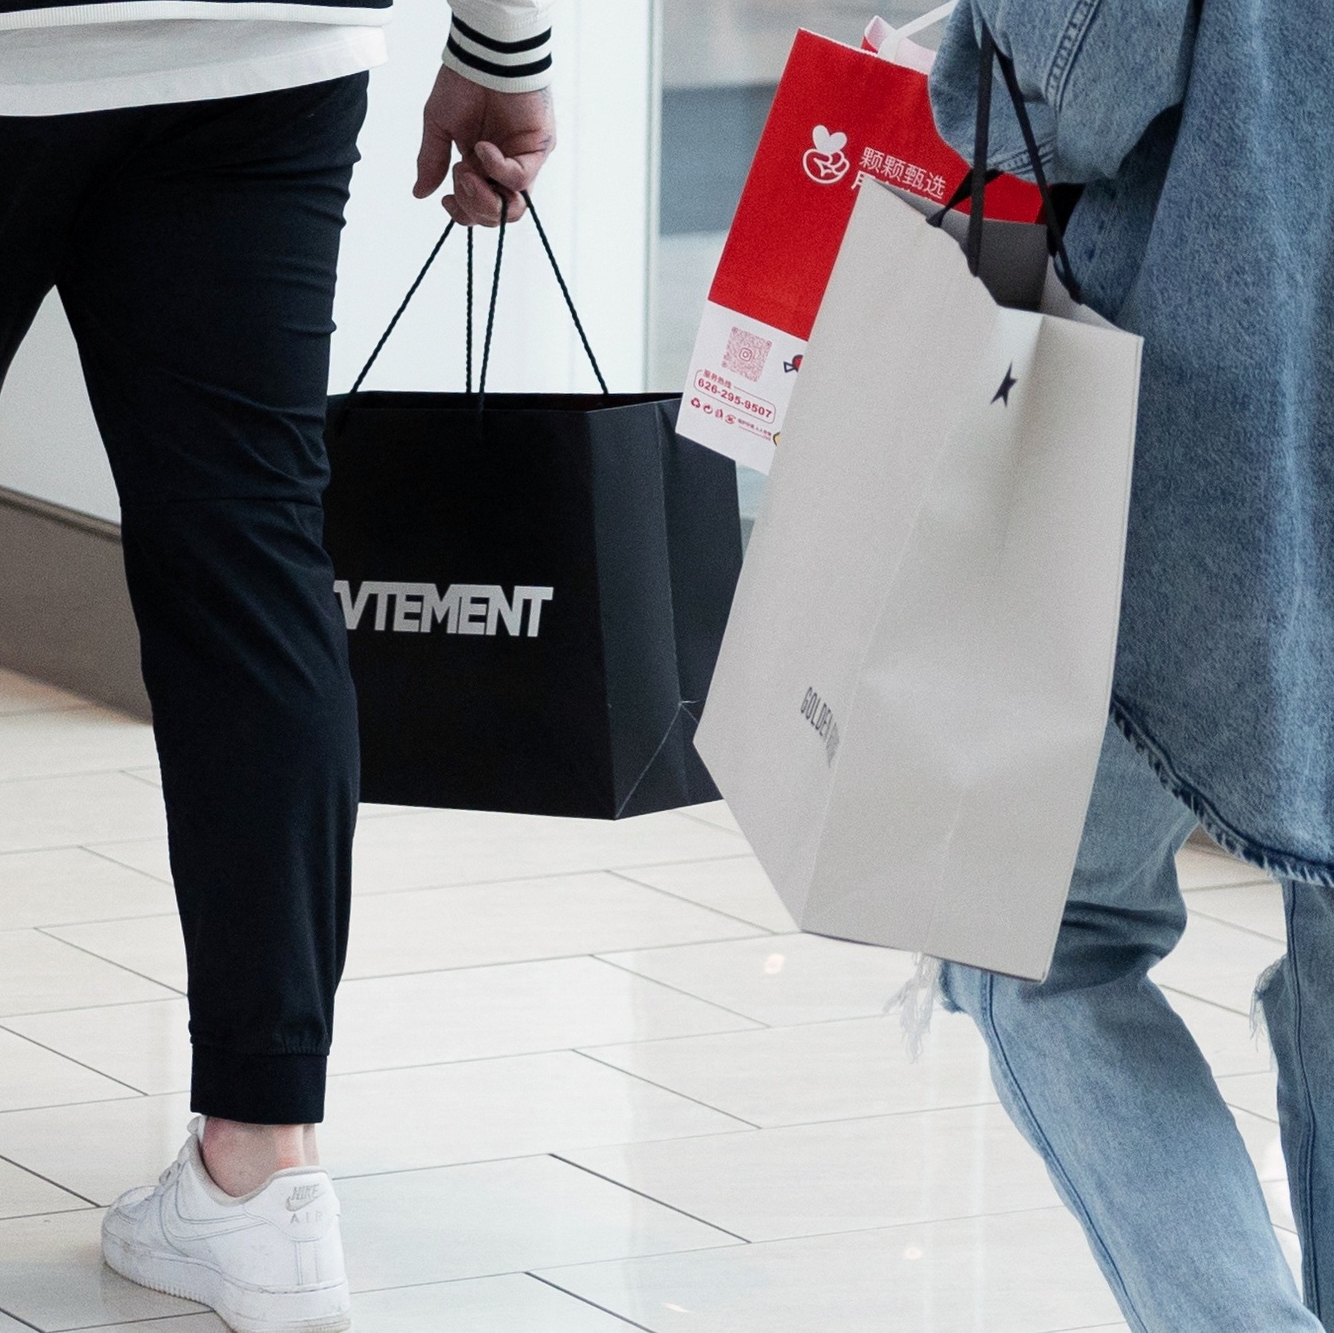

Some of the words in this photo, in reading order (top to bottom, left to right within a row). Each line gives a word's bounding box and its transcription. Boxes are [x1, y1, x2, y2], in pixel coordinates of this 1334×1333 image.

[858, 146, 946, 199] 颗颗甄选
[698, 378, 772, 418] 626-295-9507
[333, 579, 555, 638] VTEMENT
[290, 1210, 324, 1224] AIR
